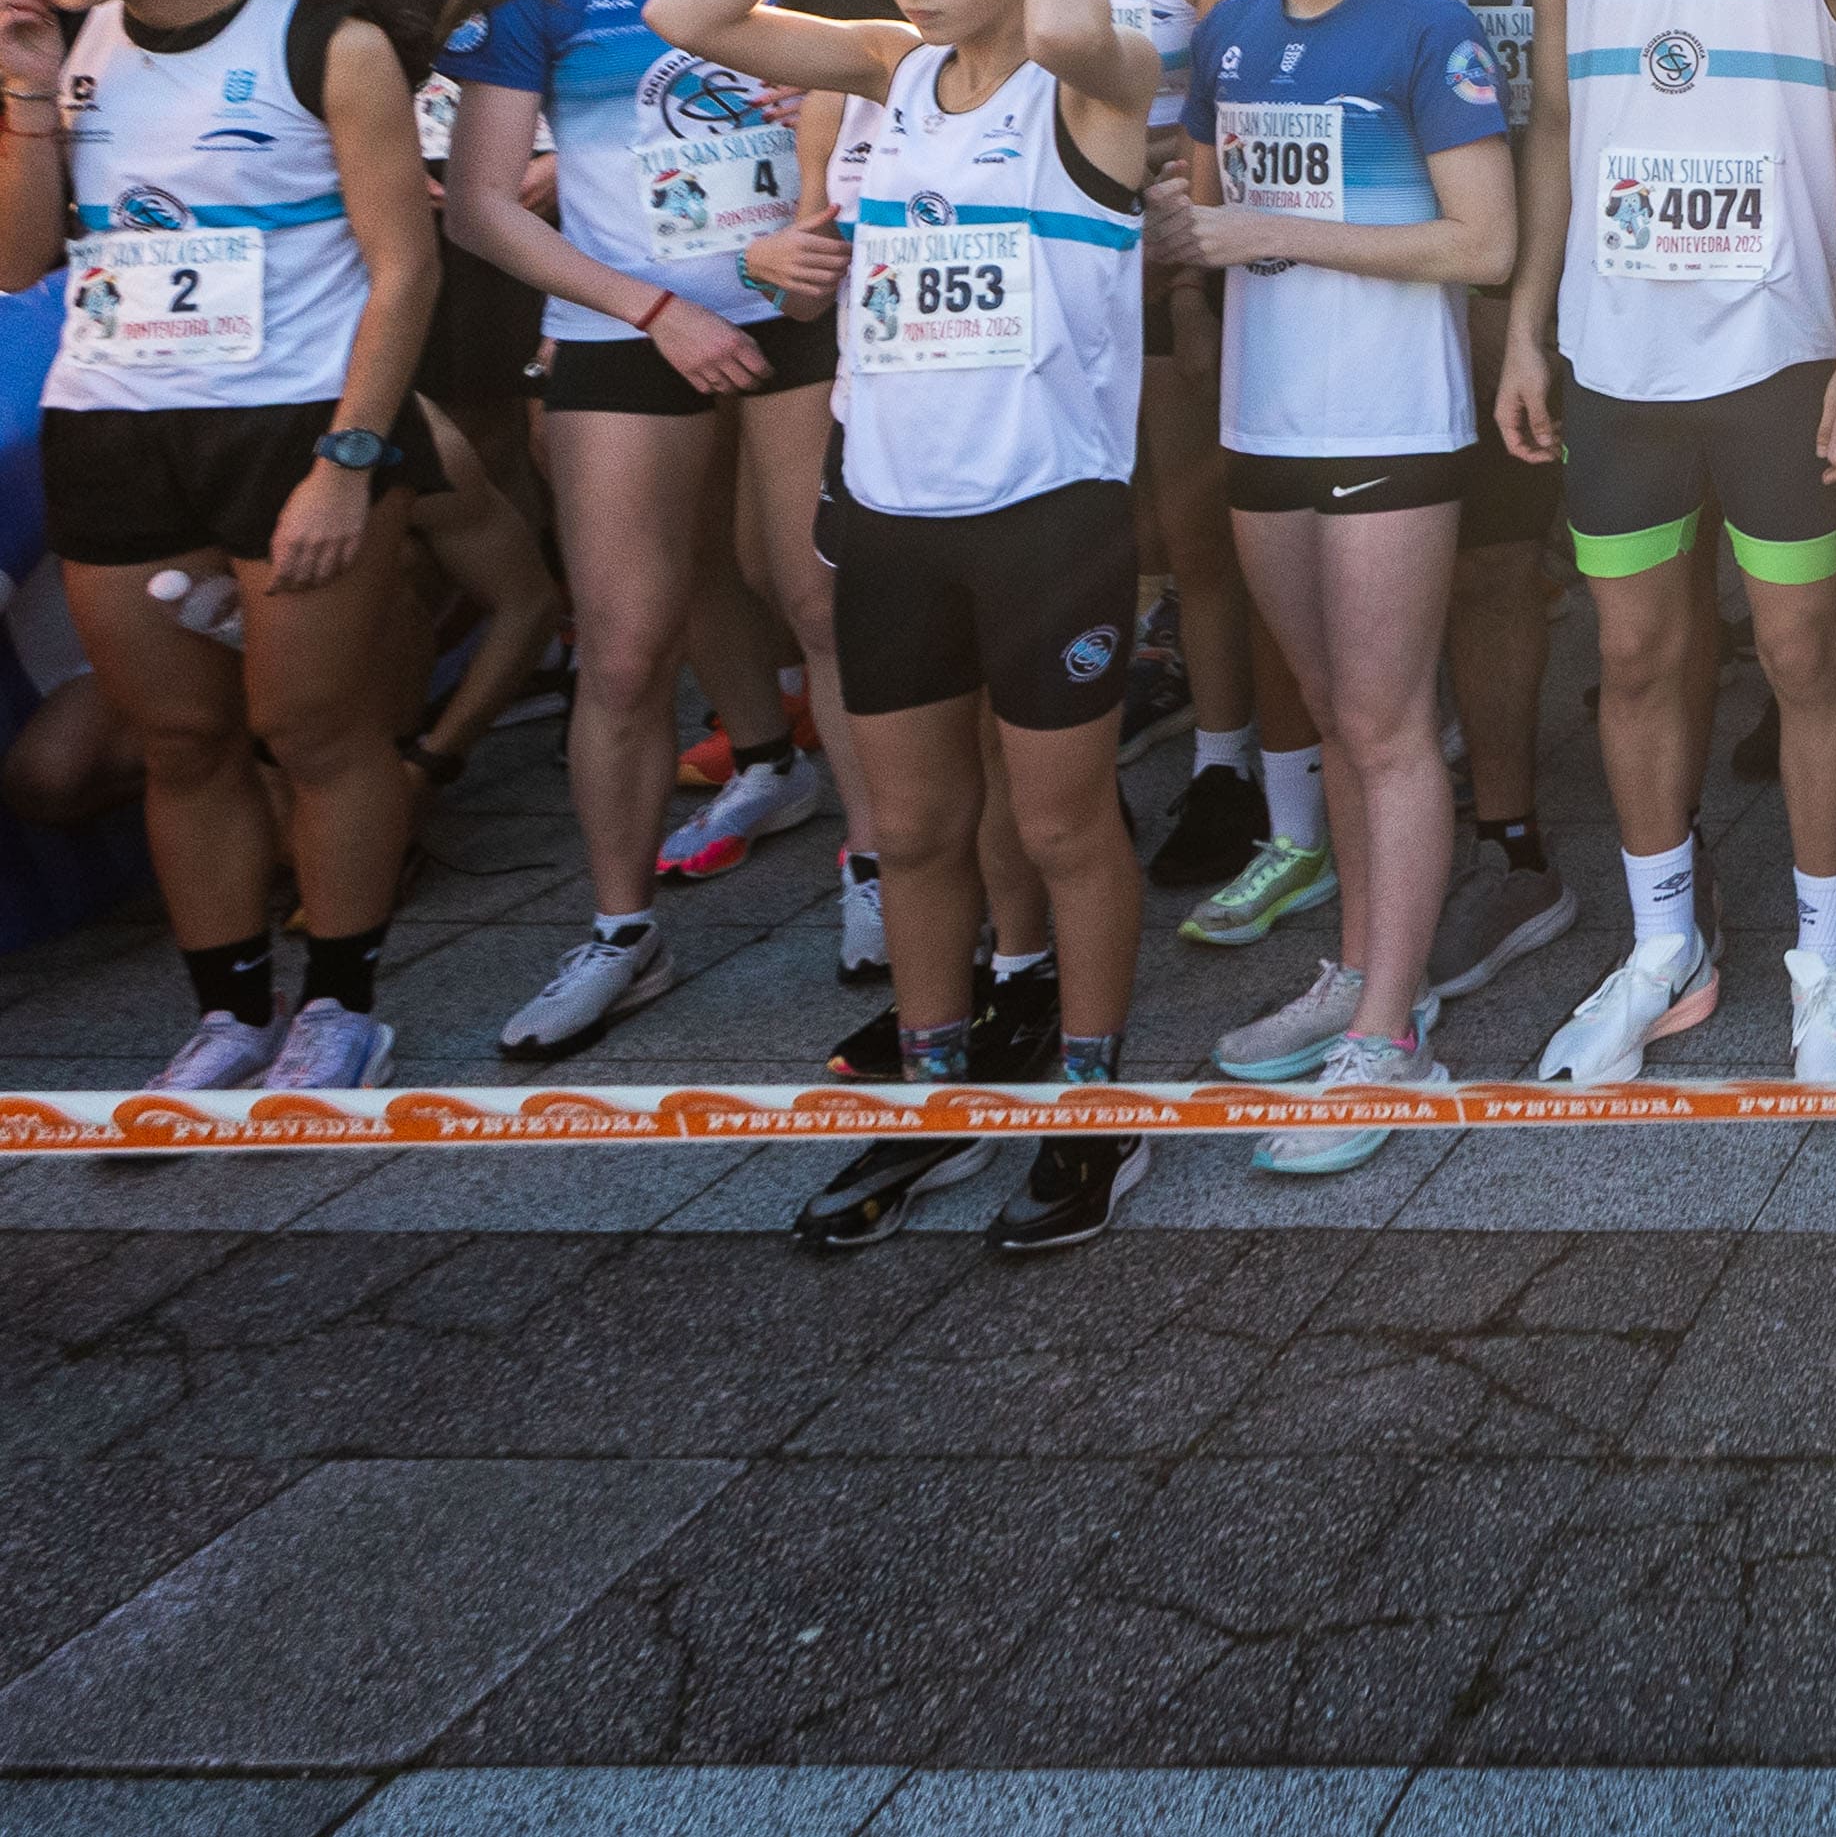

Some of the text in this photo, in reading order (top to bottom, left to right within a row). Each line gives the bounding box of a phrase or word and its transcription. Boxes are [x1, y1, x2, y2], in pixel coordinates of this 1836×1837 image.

[1263, 112, 1333, 137] SILVESTRE
[755, 160, 779, 198] 4
[1251, 140, 1329, 186] 3108
[1607, 155, 1764, 185] XLII SAN SILVESTRE
[1304, 191, 1334, 209] 2025
[1659, 187, 1762, 231] 4074
[890, 237, 919, 264] SAN
[925, 230, 1018, 263] SILVESTRE
[1656, 235, 1762, 253] PONTEVEDRA 2025
[171, 269, 199, 312] 2
[918, 264, 1004, 314] 853
[986, 315, 1023, 338] 2025
